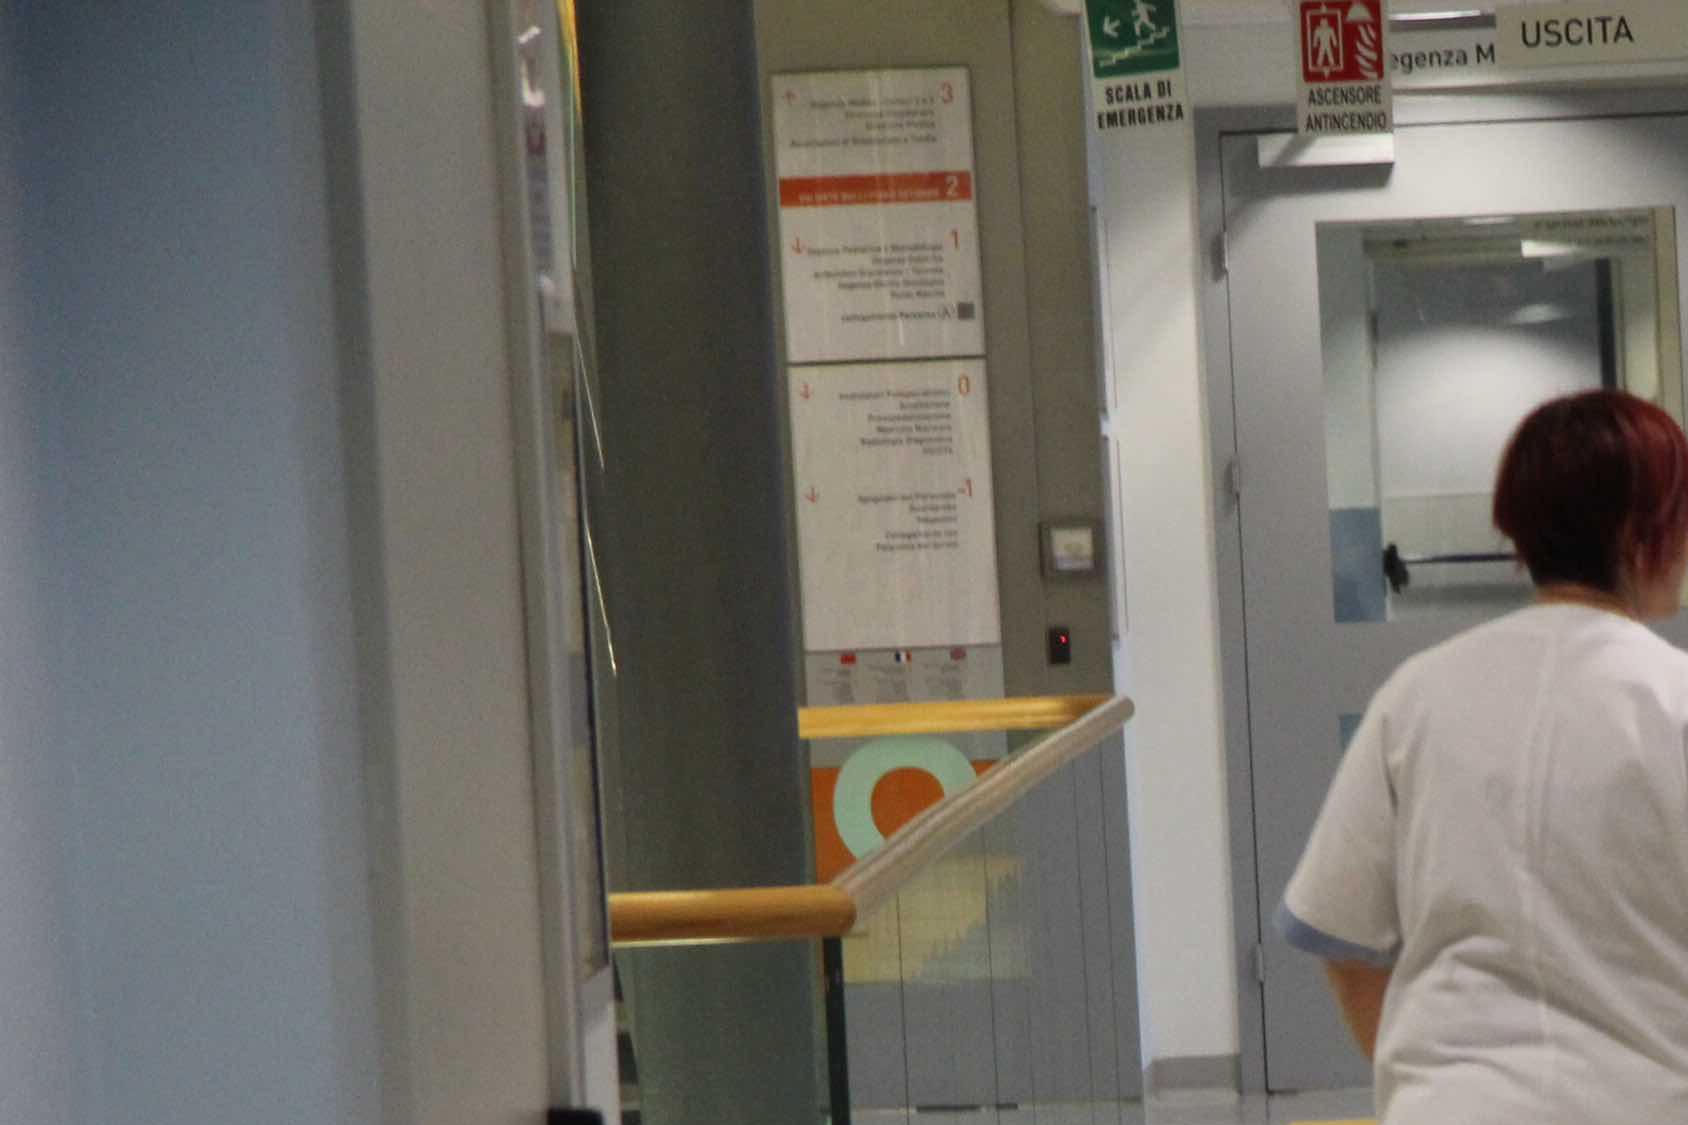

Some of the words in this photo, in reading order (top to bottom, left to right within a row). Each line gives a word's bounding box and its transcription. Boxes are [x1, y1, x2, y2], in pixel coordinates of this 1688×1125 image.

[1520, 16, 1635, 48] USCITA
[942, 81, 954, 105] 3
[1105, 83, 1152, 106] SCALA
[1157, 80, 1172, 98] DI
[1307, 85, 1382, 106] ASCENSORE
[1097, 103, 1185, 129] EMERGENZA
[1305, 111, 1387, 132] ANTINCENDIO
[945, 175, 959, 197] 2
